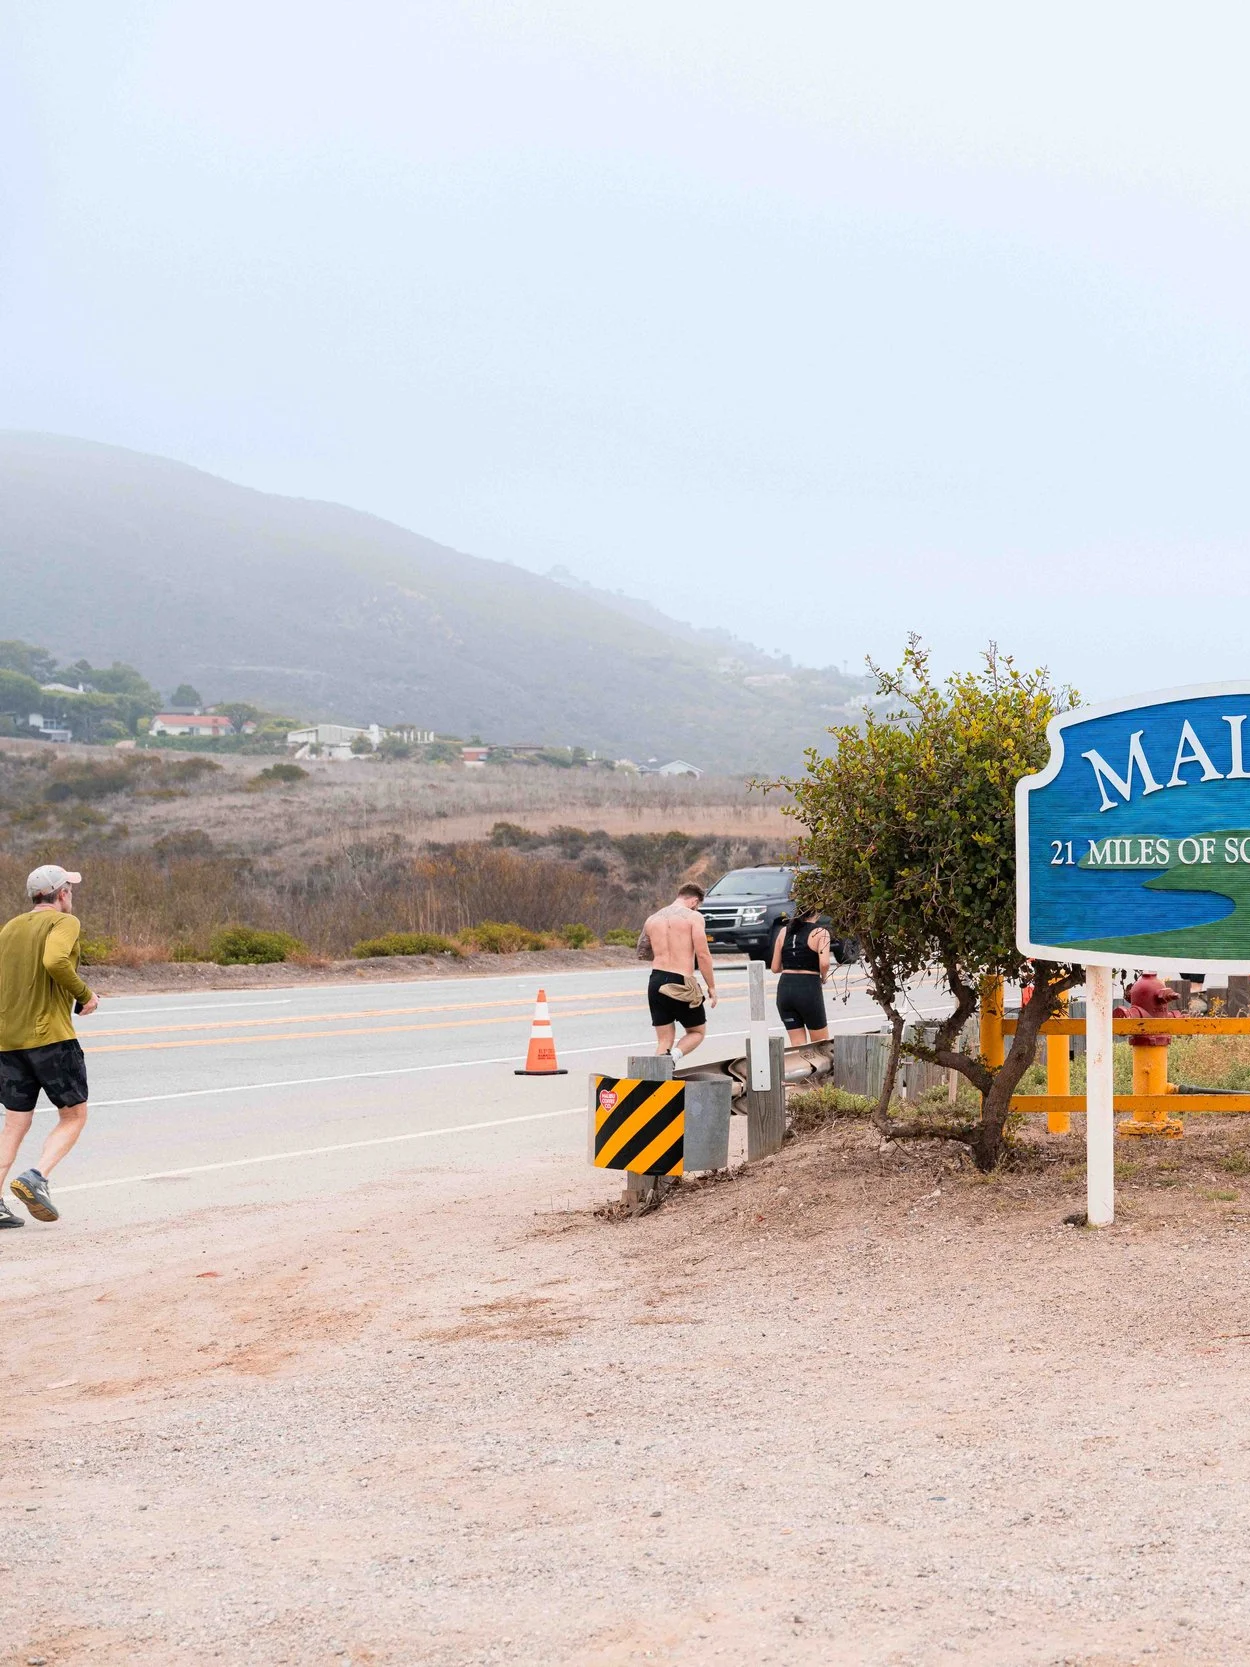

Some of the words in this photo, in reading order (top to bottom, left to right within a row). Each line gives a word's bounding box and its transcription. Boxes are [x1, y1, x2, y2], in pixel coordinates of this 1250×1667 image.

[1050, 840, 1076, 865] 21
[1087, 838, 1170, 865] MILES
[1177, 837, 1216, 865] OF
